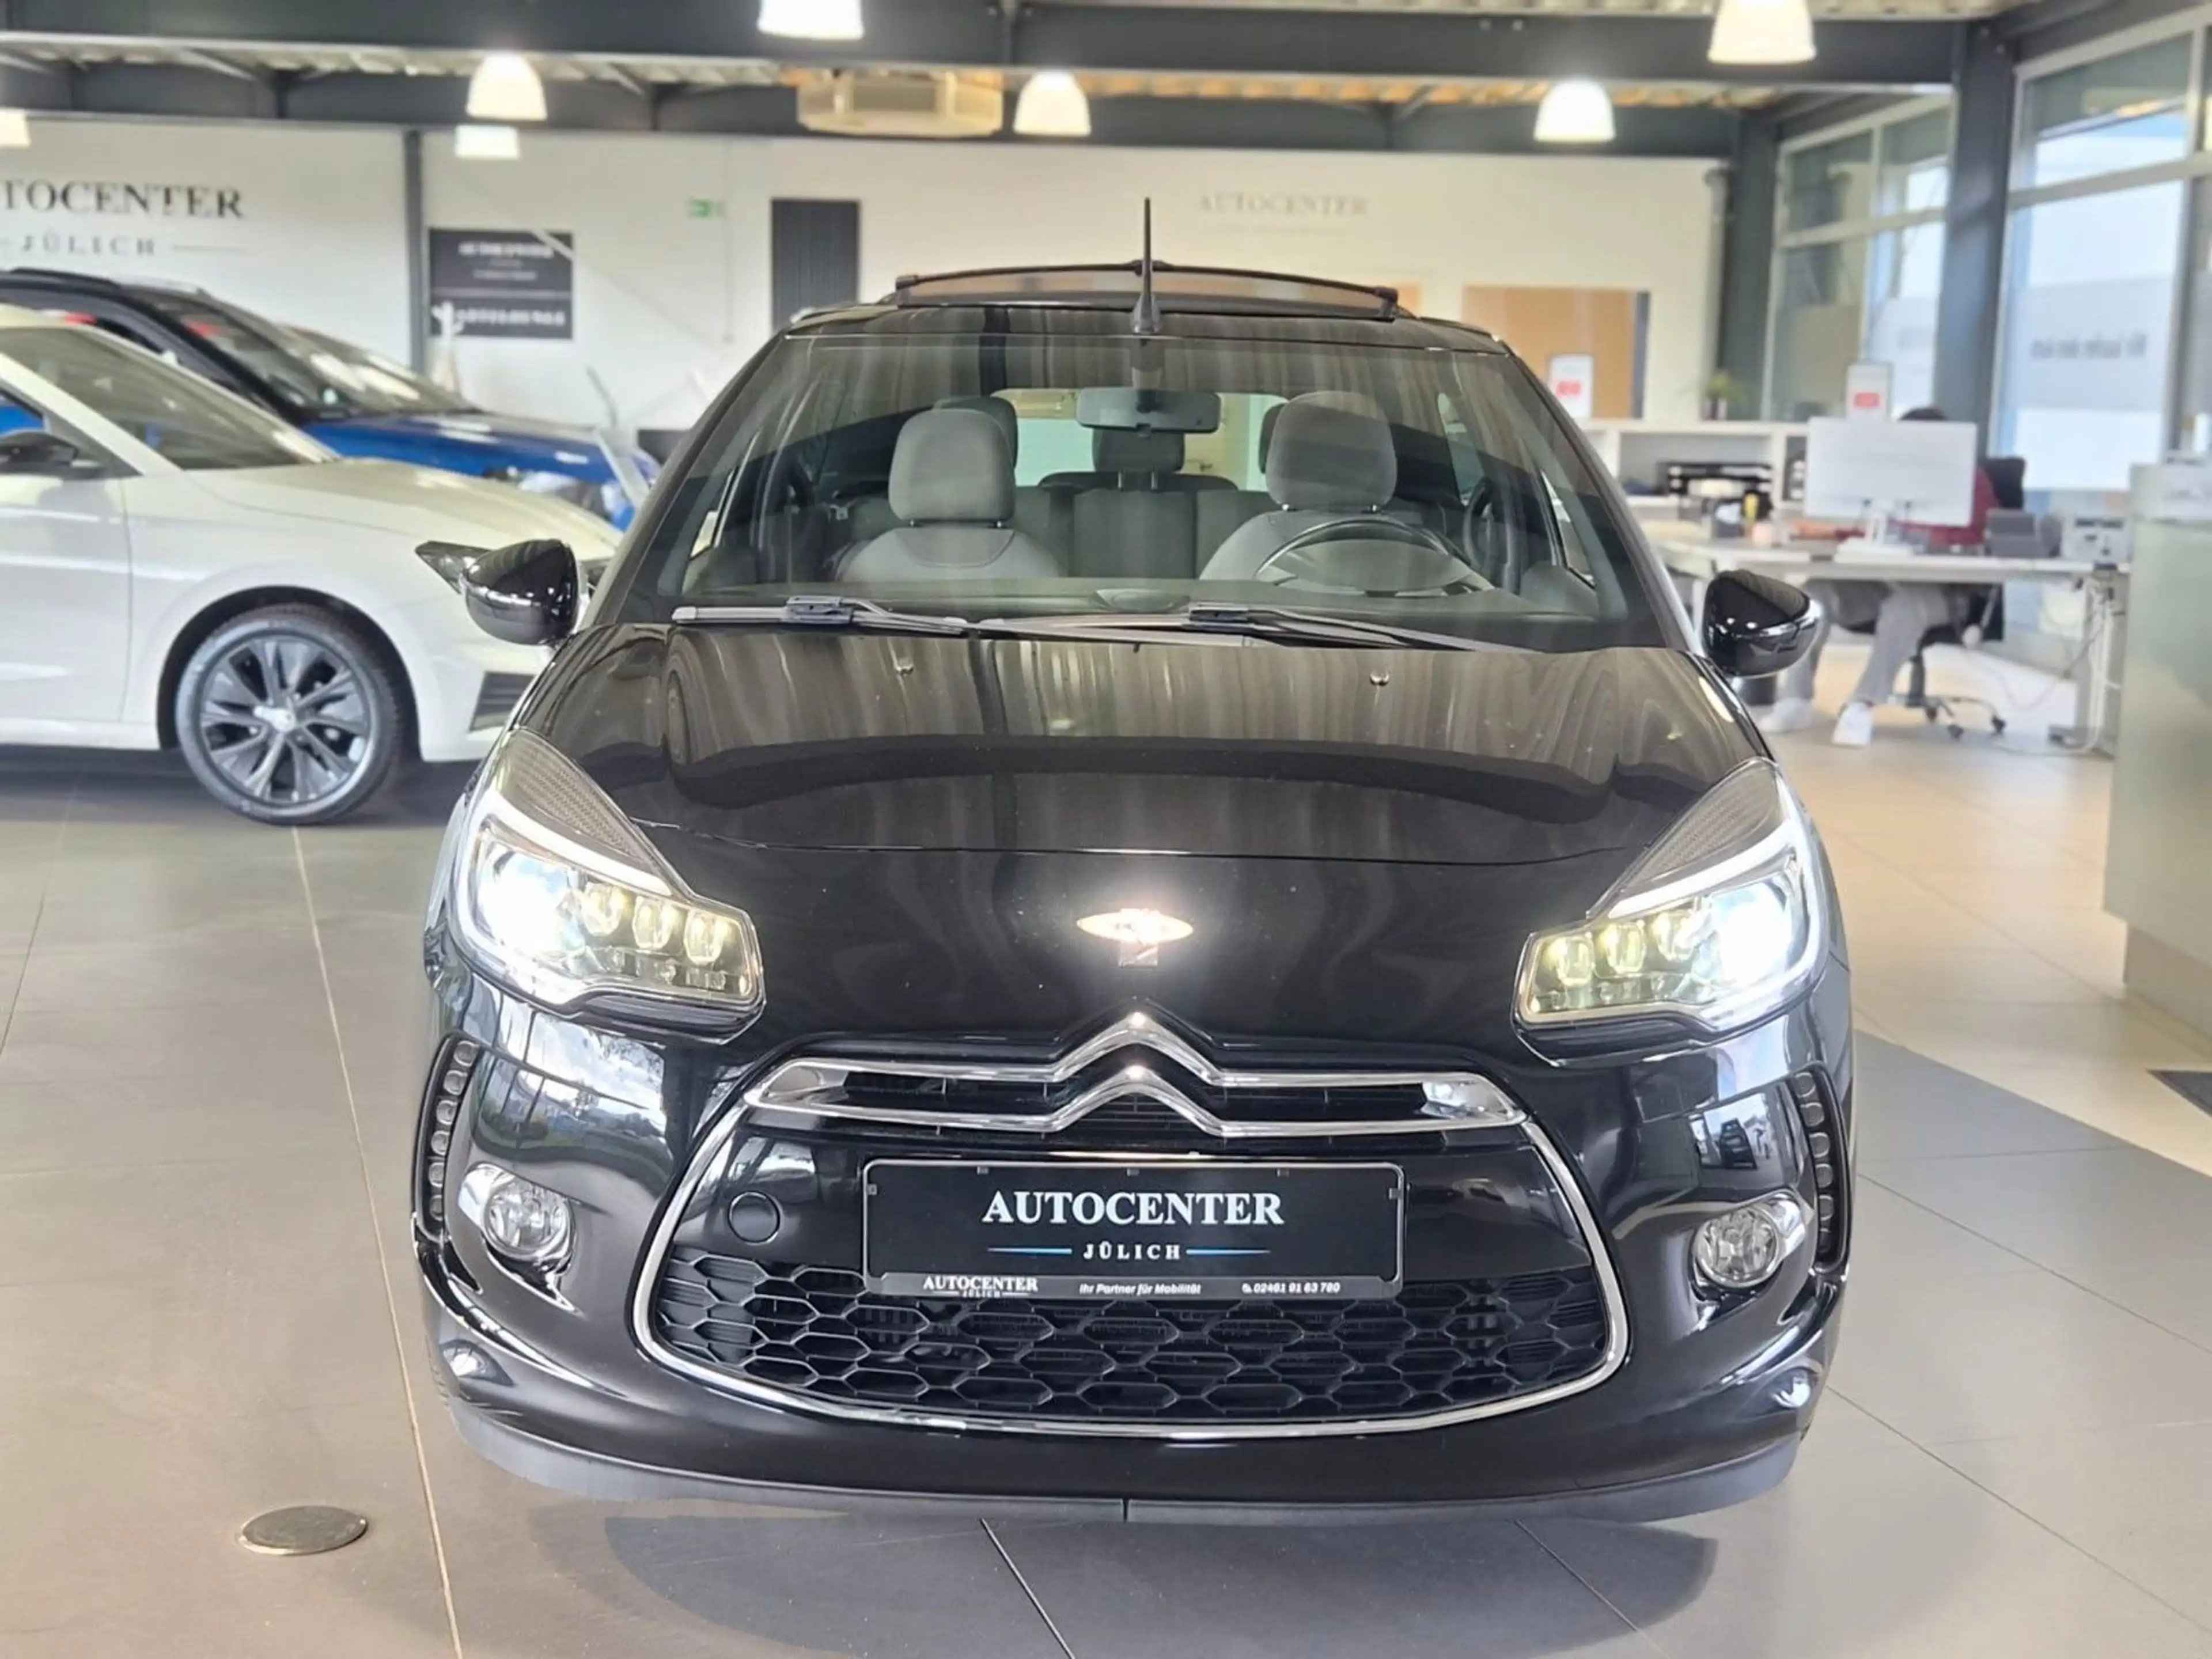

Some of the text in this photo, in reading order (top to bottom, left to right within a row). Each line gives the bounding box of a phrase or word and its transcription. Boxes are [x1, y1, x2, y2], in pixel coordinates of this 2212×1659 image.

[982, 1190, 1285, 1225] AUTOCENTER
[1083, 1241, 1180, 1260] JÜLICH
[923, 1275, 1038, 1291] AUTOCENTER
[1096, 1283, 1136, 1294] Partner
